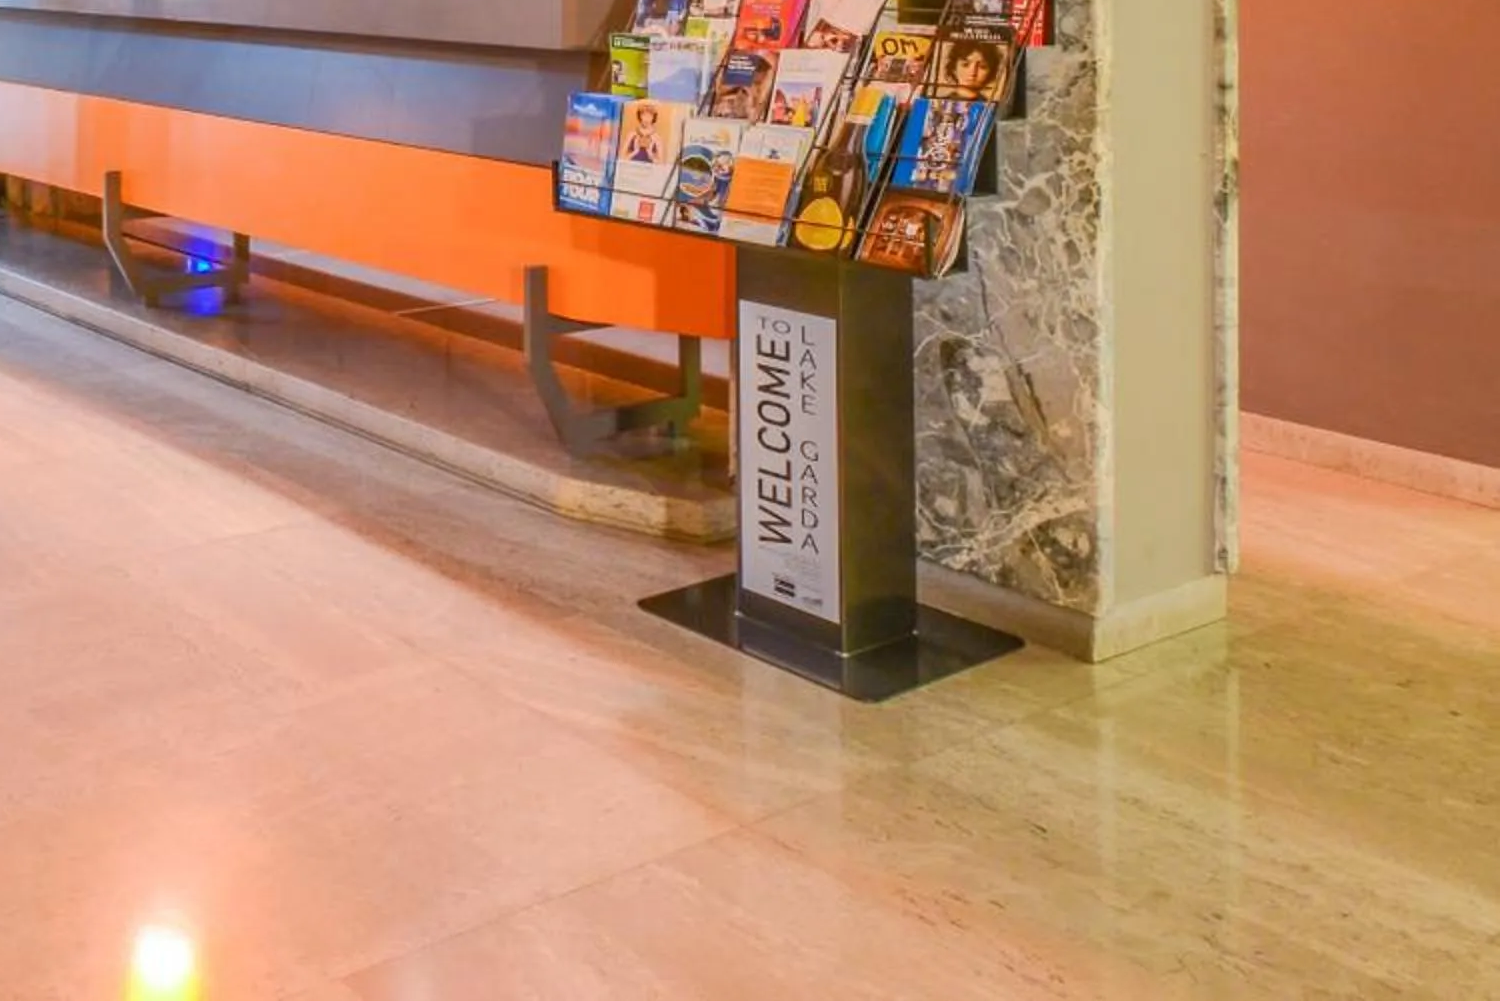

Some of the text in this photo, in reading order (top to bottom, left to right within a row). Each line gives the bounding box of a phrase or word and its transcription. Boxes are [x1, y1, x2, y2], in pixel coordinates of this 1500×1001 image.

[756, 314, 791, 335] TO
[756, 334, 793, 546] WELCOME
[799, 325, 820, 555] LAKE GARDA
